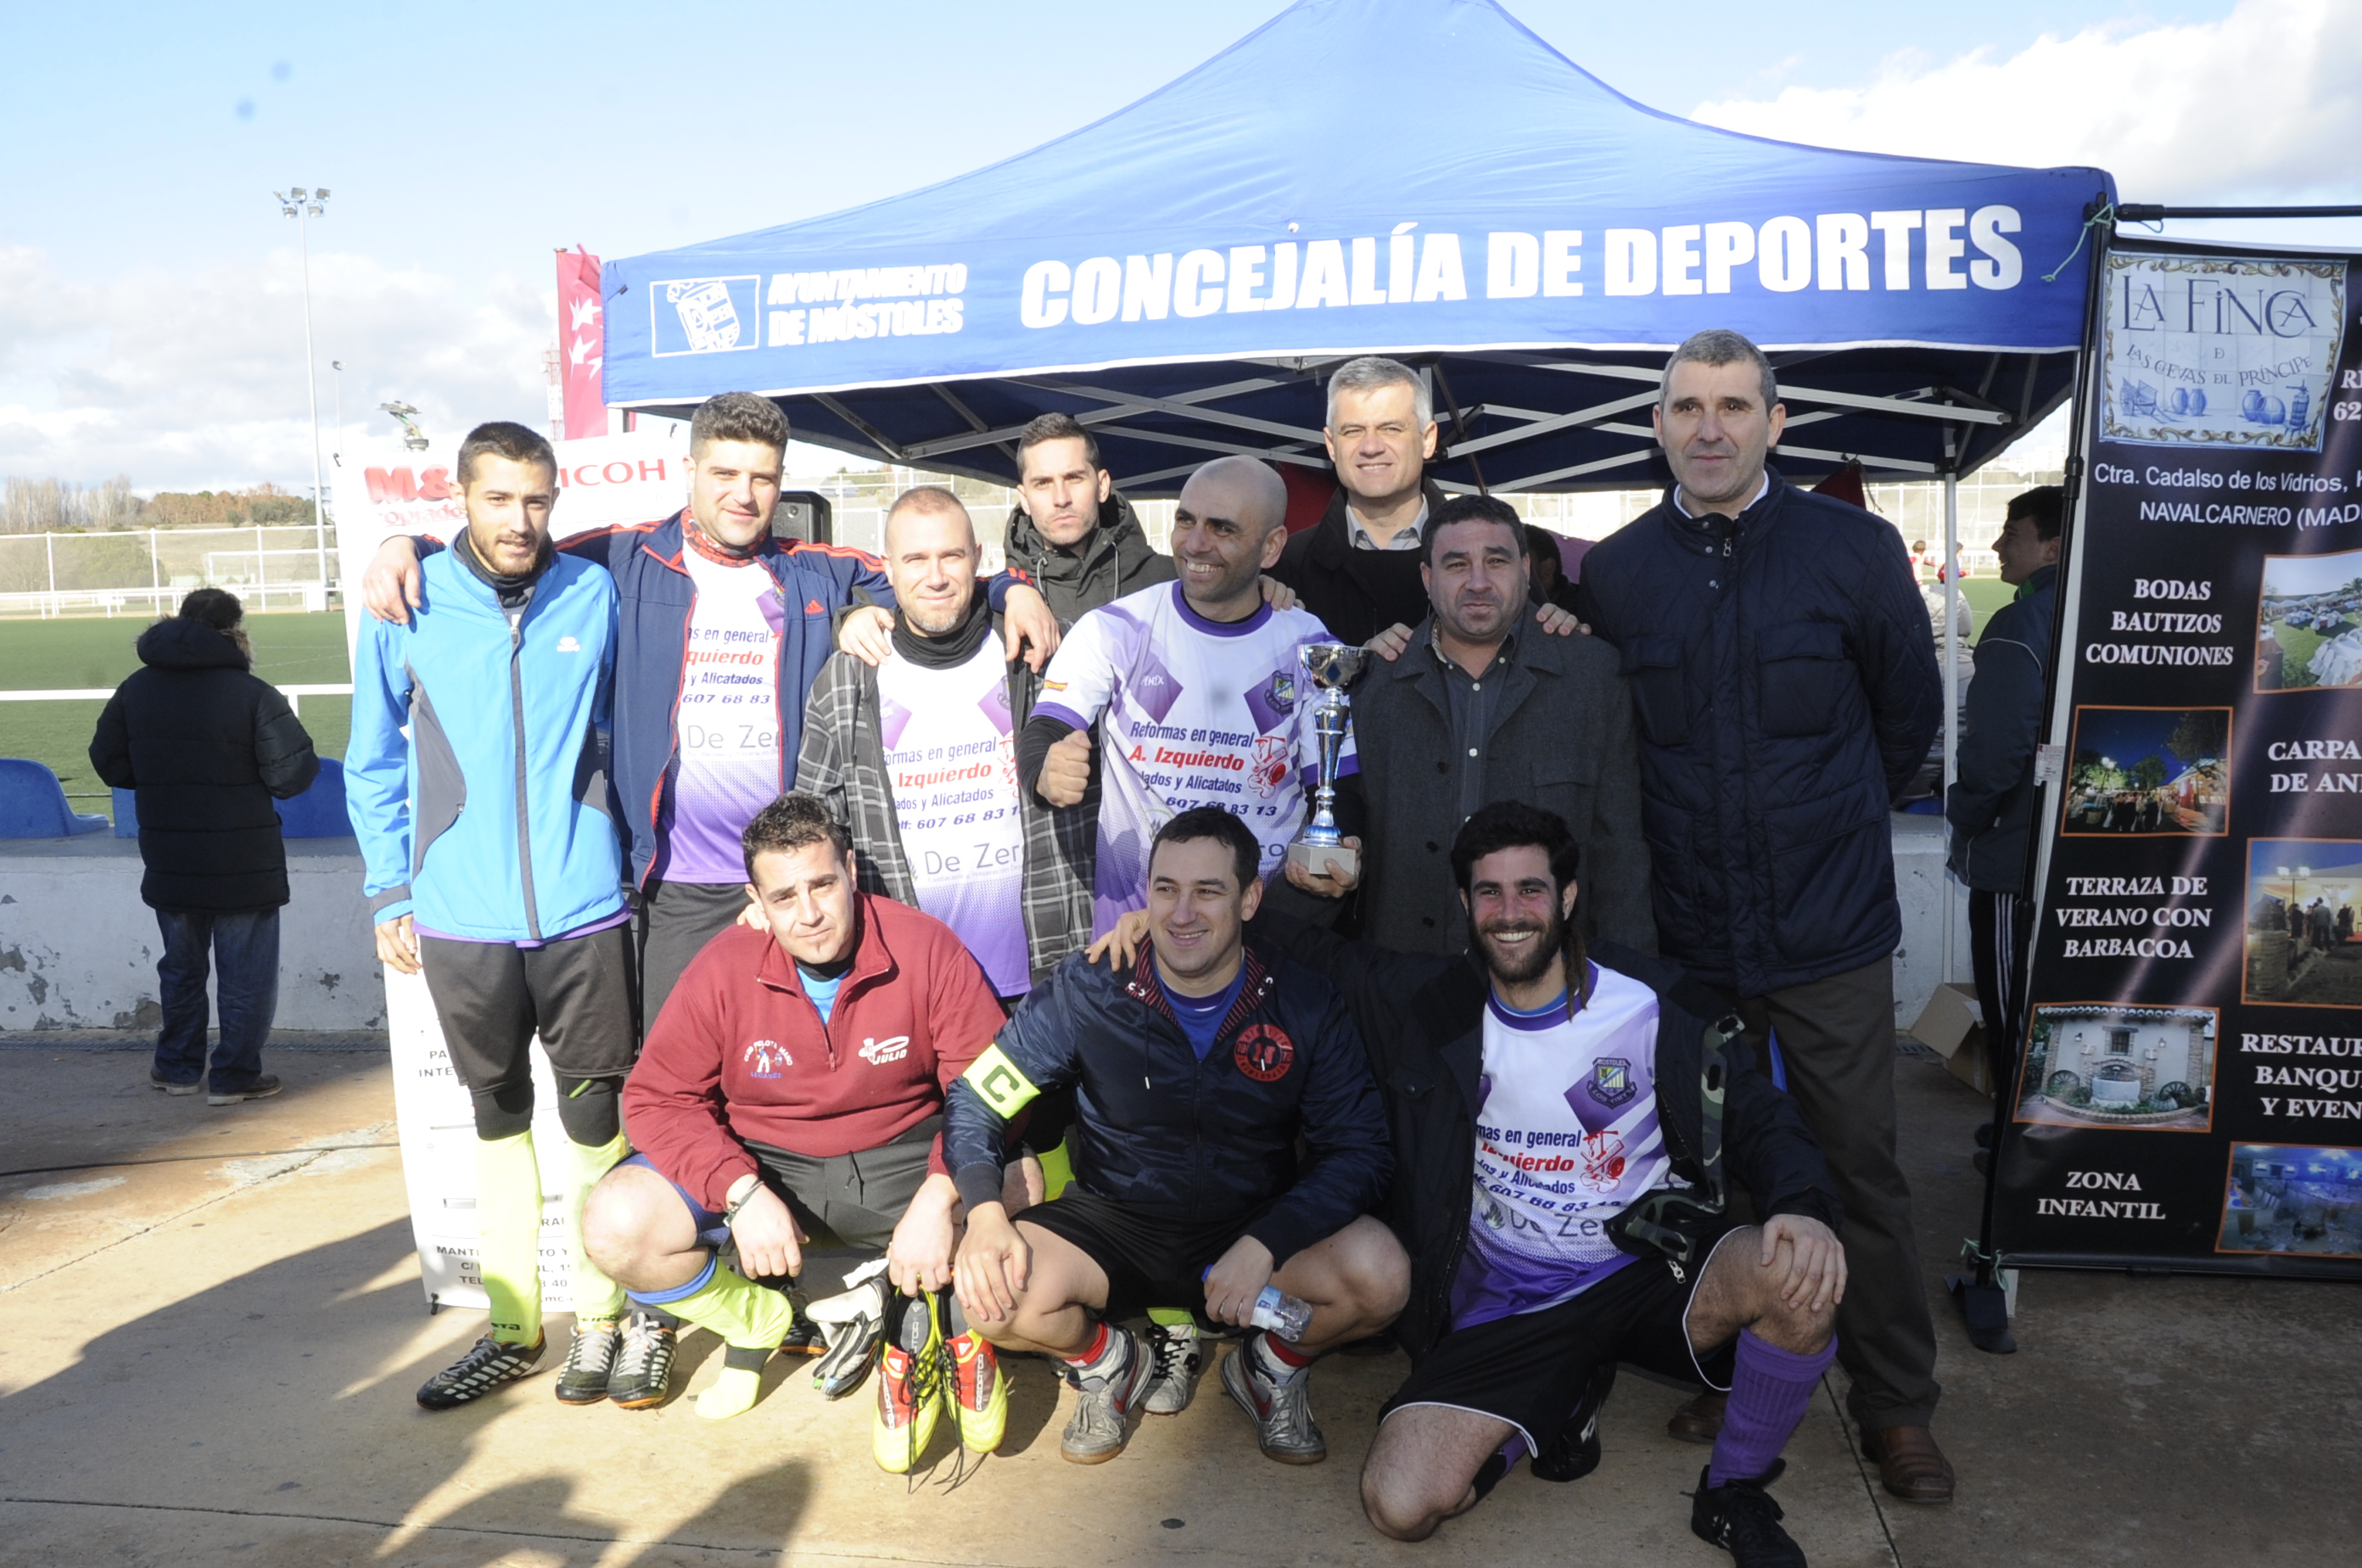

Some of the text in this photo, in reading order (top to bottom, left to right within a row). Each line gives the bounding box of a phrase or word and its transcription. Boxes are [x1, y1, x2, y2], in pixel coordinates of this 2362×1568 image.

[1020, 204, 2023, 331] CONCEJALÍA DE DEPORTES
[767, 263, 968, 305] AYUNTAMIENTO
[2122, 274, 2165, 332] LA
[768, 310, 806, 347] DE
[807, 298, 965, 344] MÓSTOLES
[2126, 343, 2152, 369] LAS
[2238, 355, 2314, 387] PRÍNCIPE
[558, 458, 666, 489] ICOH
[2094, 462, 2140, 484] Ctra.
[2146, 466, 2224, 489] Cadalso
[2228, 470, 2251, 490] de
[2255, 471, 2277, 491] los
[2281, 472, 2348, 494] Vidrios,
[2140, 501, 2362, 531] NAVALCARNERO (MAD
[2133, 579, 2212, 601] BODAS
[2110, 611, 2222, 634] BAUTIZOS
[704, 628, 719, 641] en
[723, 629, 770, 645] general
[686, 648, 764, 666] quierdo
[2085, 643, 2234, 666] COMUNIONES
[701, 671, 764, 685] Alicatados
[682, 693, 770, 704] 607 68 83
[687, 725, 724, 748] De
[1130, 721, 1255, 748] Reformas en general
[928, 746, 943, 761] en
[949, 736, 997, 762] general
[1128, 745, 1245, 771] A. Izquierdo
[898, 762, 993, 789] Izquierdo
[1174, 776, 1184, 791] y
[2270, 772, 2362, 793] DE AN
[921, 798, 927, 812] y
[932, 788, 994, 808] Alicatados
[1165, 797, 1200, 809] 607
[1230, 804, 1250, 815] 83
[1256, 805, 1278, 816] 13
[916, 817, 948, 830] 607
[953, 812, 976, 826] 68
[982, 808, 1005, 821] 83
[924, 849, 960, 876] De
[2066, 876, 2208, 896] TERRAZA DE
[2056, 907, 2213, 927] VERANO CON
[2063, 938, 2195, 959] BARBACOA
[872, 1048, 908, 1066] JULIO
[981, 1063, 1021, 1104] C
[2253, 1066, 2362, 1094] BANQU
[2259, 1097, 2281, 1116] Y
[1505, 1129, 1523, 1144] en
[1526, 1129, 1582, 1149] general
[2065, 1171, 2142, 1191] ZONA
[2036, 1198, 2166, 1220] INFANTIL
